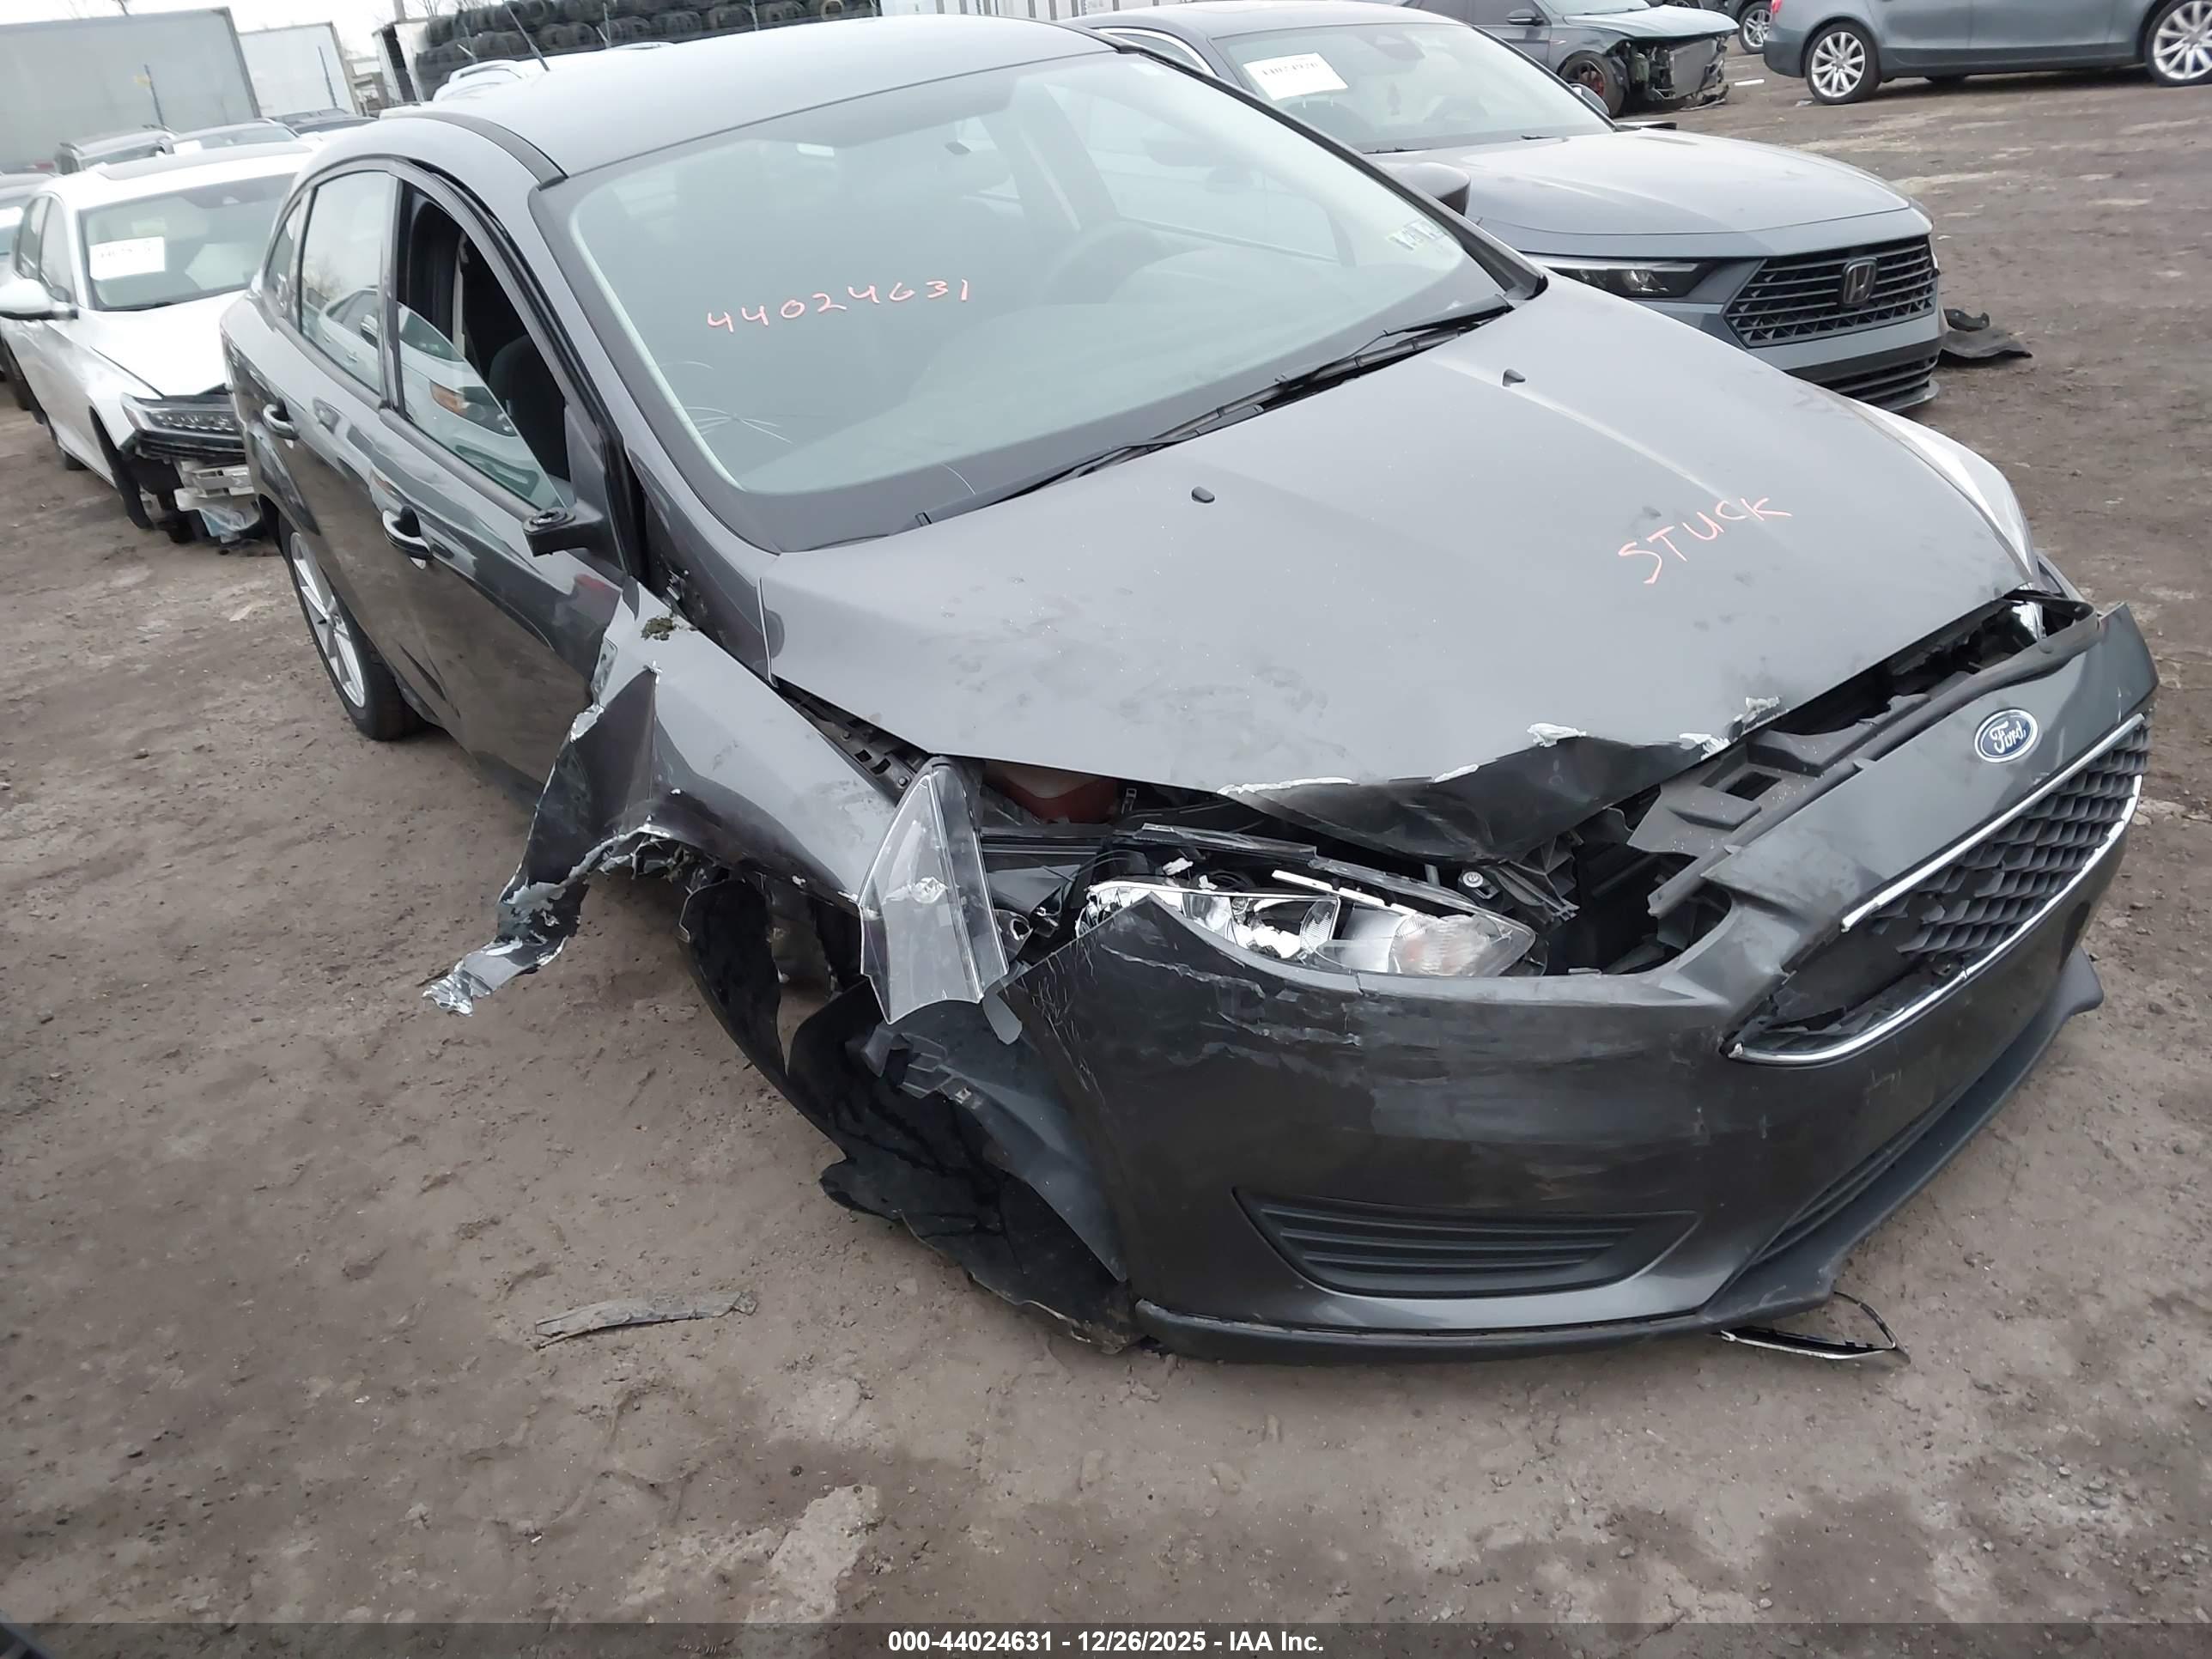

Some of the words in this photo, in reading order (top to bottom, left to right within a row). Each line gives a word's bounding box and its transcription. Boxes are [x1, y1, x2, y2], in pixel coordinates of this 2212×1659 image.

[707, 278, 969, 333] 44024631
[1618, 497, 1793, 584] STUCK
[1989, 720, 2027, 754] Ford
